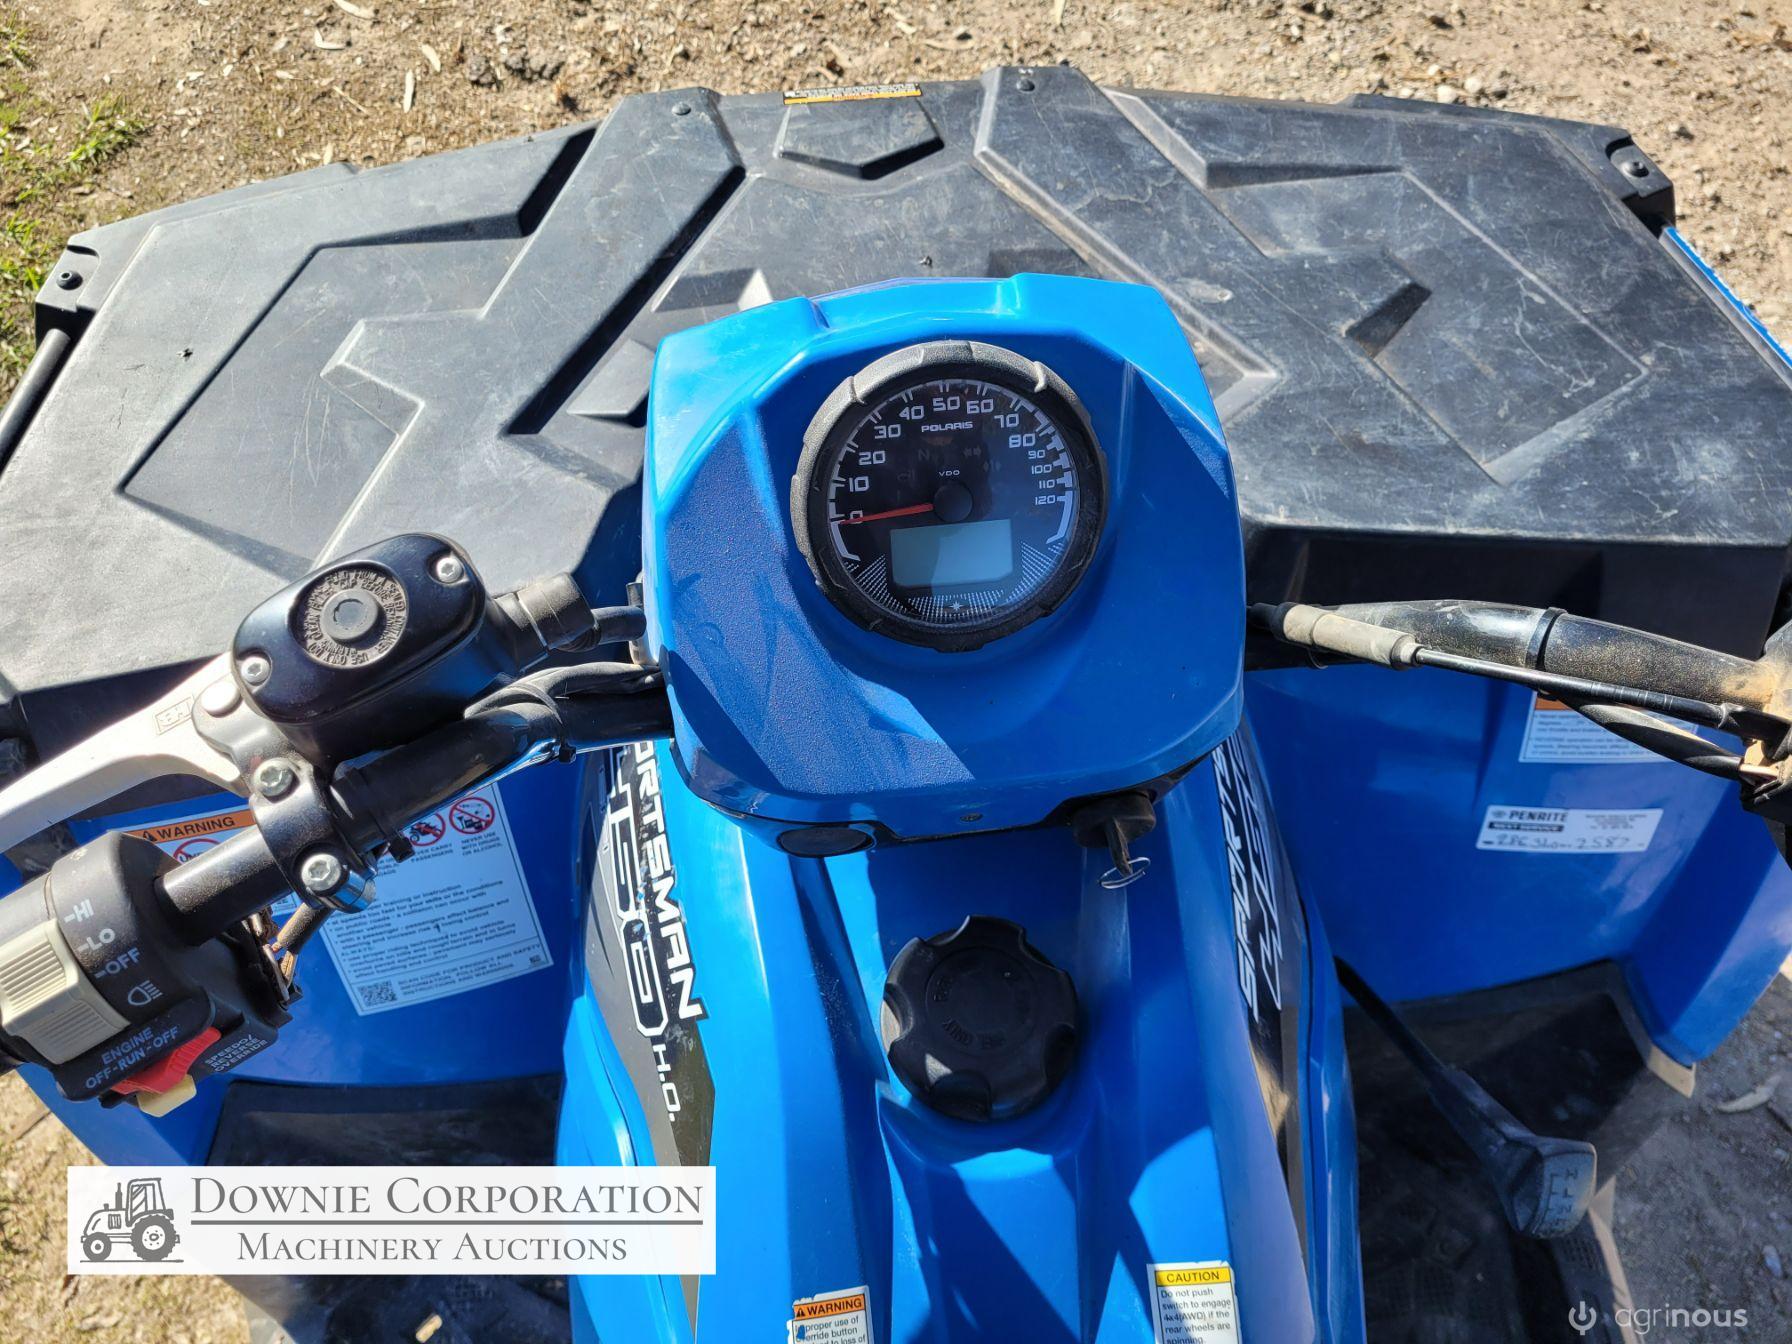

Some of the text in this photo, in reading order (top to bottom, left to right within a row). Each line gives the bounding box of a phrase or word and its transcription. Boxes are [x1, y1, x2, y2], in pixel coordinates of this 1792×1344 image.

[932, 396, 961, 412] 50
[966, 399, 994, 414] 60
[898, 405, 925, 420] 40
[921, 421, 973, 432] POLARIS
[994, 413, 1020, 428] 70
[874, 423, 901, 439] 30
[1008, 433, 1036, 448] 80
[858, 450, 886, 465] 20
[1027, 449, 1046, 460] 90
[938, 469, 961, 477] VDO
[1031, 463, 1053, 475] 100
[849, 475, 869, 492] 10
[1038, 479, 1056, 490] 110
[1034, 495, 1056, 506] 120
[1509, 810, 1568, 822] PENRITE
[157, 816, 235, 839] WARNING
[634, 741, 704, 1020] ORTSMAN
[1212, 742, 1259, 1025] SPORTS
[75, 899, 94, 923] HI
[90, 928, 116, 951] LO
[105, 948, 141, 974] OFF
[102, 1027, 154, 1065] ENGINE
[211, 1038, 260, 1068] REVERSE
[215, 1039, 268, 1072] OVERRIDE
[653, 1043, 682, 1122] H.O.
[1166, 1271, 1220, 1283] CAUTION
[1160, 1287, 1214, 1298] Do not push
[807, 1298, 862, 1316] WARNING
[1162, 1299, 1231, 1310] switch to engage
[834, 1318, 849, 1326] use
[851, 1315, 859, 1324] of
[1216, 1310, 1230, 1318] the
[831, 1327, 858, 1338] button
[1165, 1322, 1231, 1334] rear wheels are
[858, 1334, 866, 1342] of
